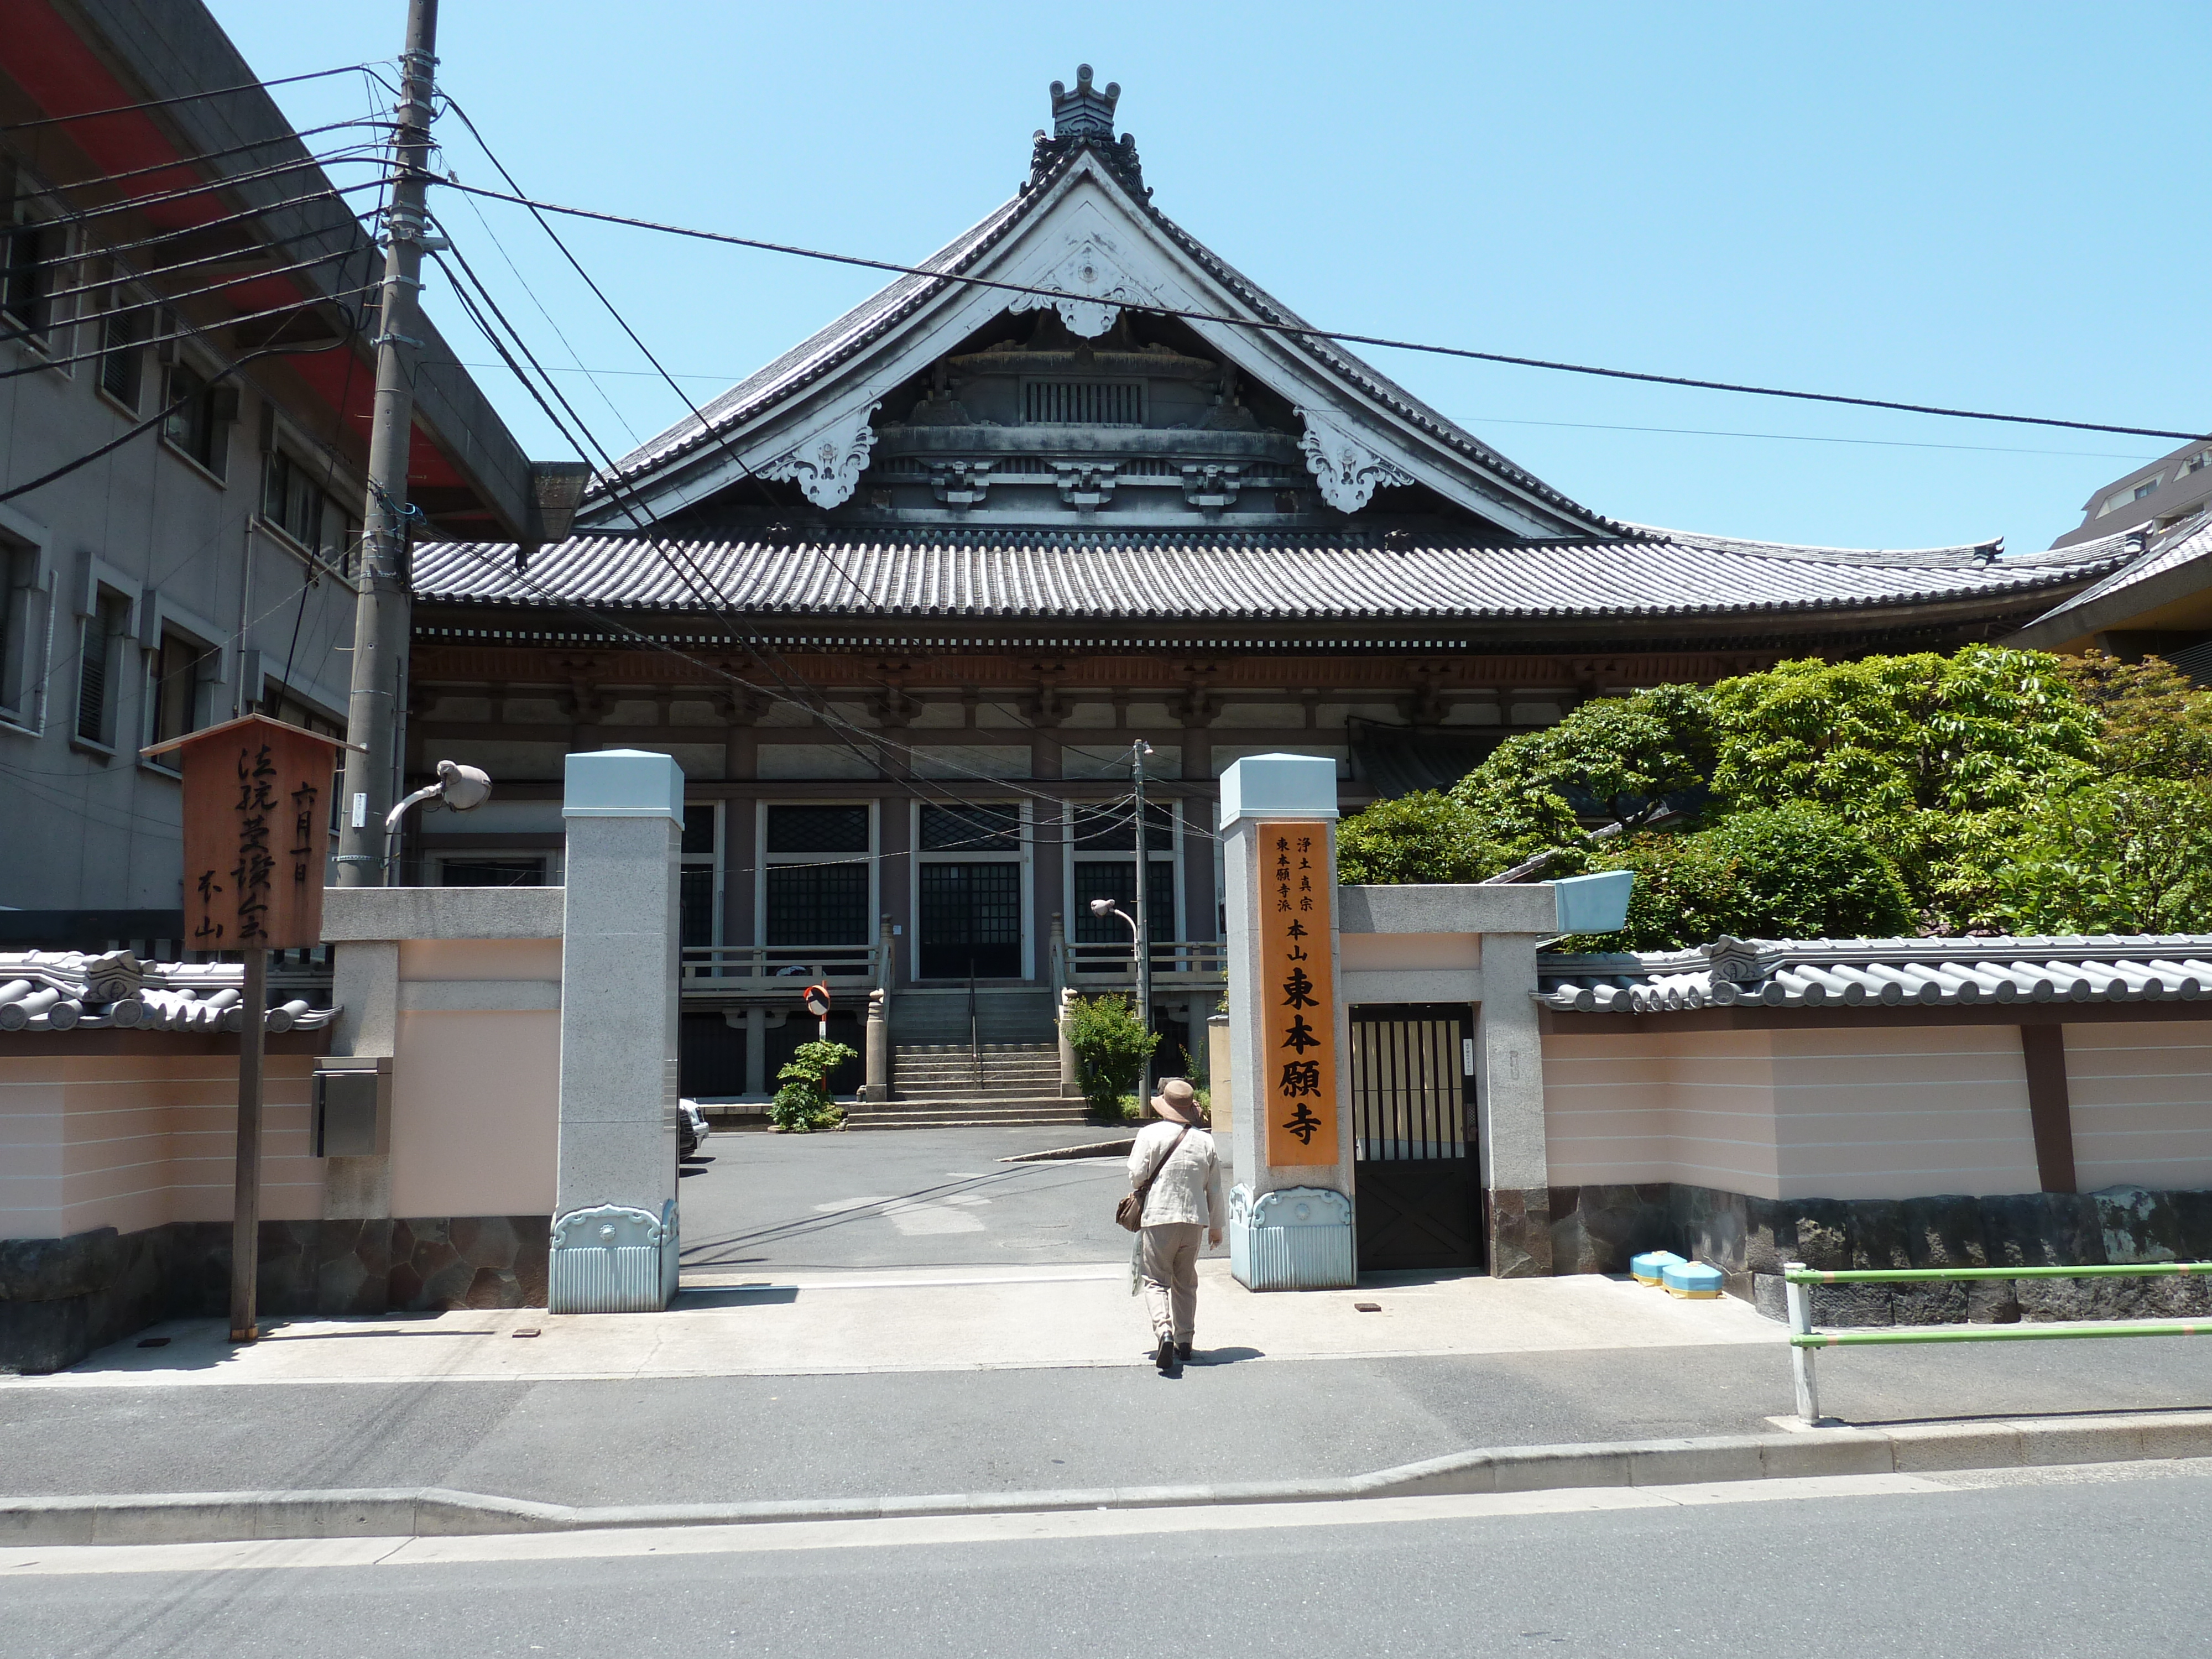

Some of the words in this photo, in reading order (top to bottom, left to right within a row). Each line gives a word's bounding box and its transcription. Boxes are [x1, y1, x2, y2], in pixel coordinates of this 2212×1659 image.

[289, 781, 318, 883] 六月一日
[194, 869, 223, 939] 本山
[1275, 836, 1293, 913] 東本願寺派
[1296, 837, 1313, 912] 浄土真宗
